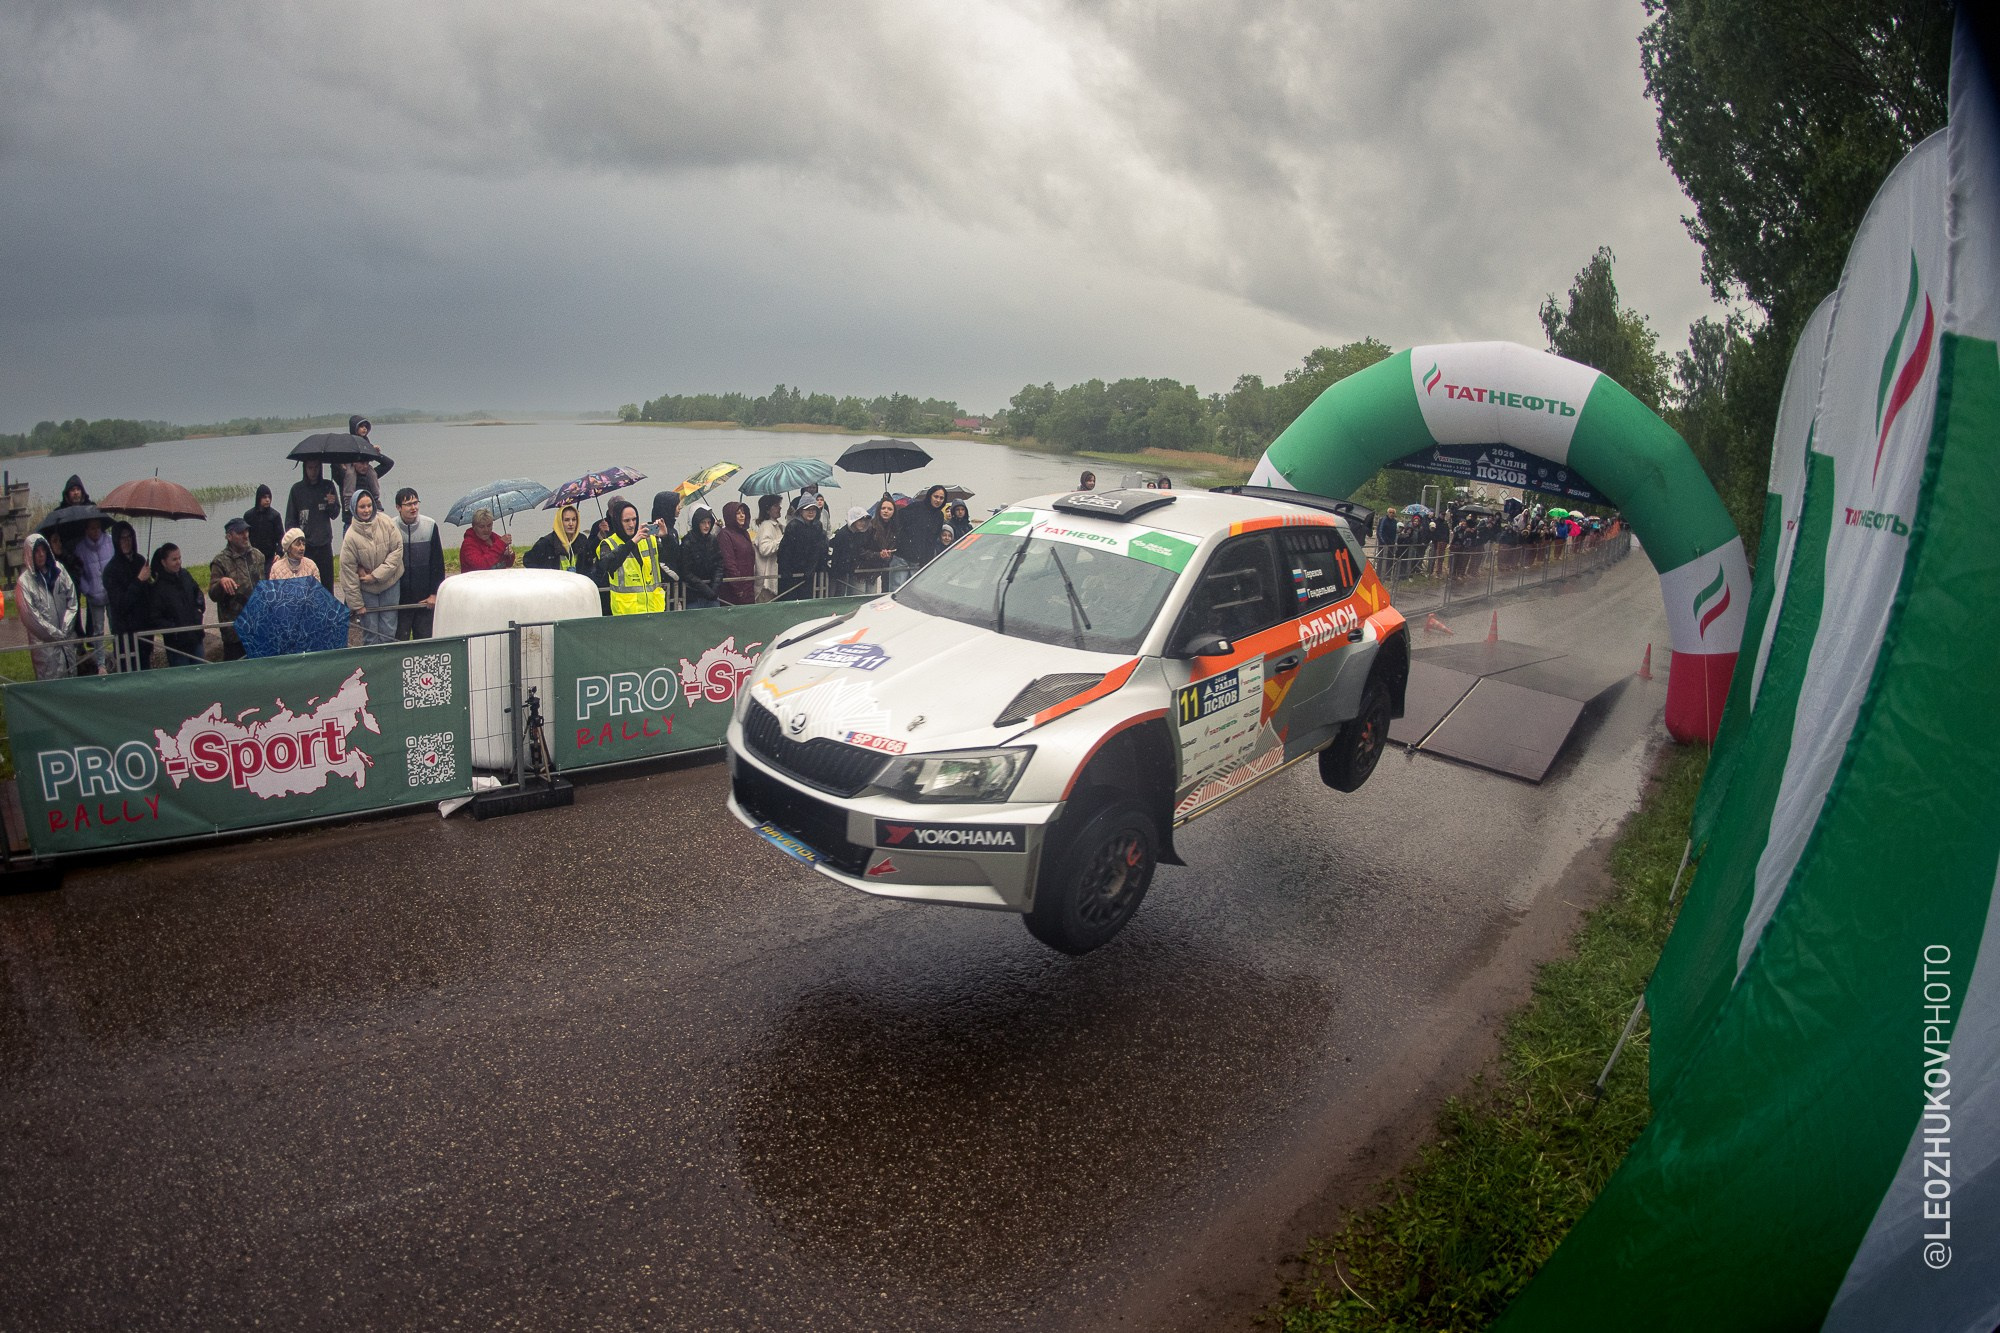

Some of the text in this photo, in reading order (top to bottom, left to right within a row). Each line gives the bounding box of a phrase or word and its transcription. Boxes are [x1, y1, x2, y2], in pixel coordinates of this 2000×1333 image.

[1444, 384, 1576, 417] ТАТНЕФТЬ
[1476, 465, 1528, 486] ПСКОВ
[1494, 457, 1528, 470] РАЛЛИ
[1845, 507, 1909, 537] ТАТНЕФТЬ
[1044, 526, 1119, 546] ТАТНЕФТЬ
[1335, 547, 1354, 588] 11
[1299, 604, 1360, 652] ОЛЬХОН
[857, 655, 886, 669] 11
[1215, 677, 1237, 693] РАЛЛИ
[1180, 687, 1199, 722] 11
[1203, 689, 1238, 715] ПСКОВ
[576, 713, 676, 749] RALLY
[851, 733, 905, 753] SP 0766
[48, 794, 162, 833] RALLY
[914, 828, 1016, 846] YOKOHAMA
